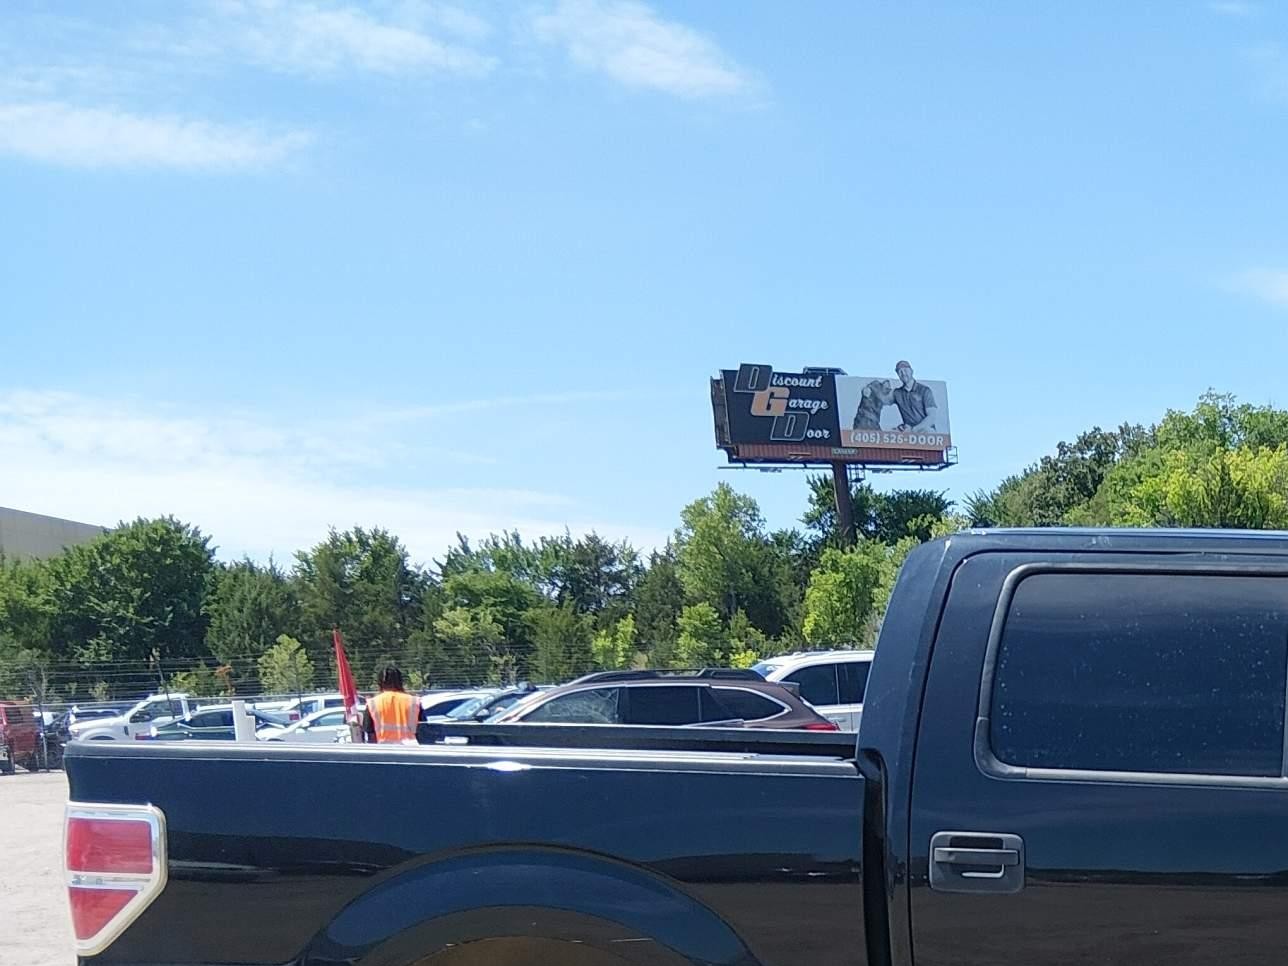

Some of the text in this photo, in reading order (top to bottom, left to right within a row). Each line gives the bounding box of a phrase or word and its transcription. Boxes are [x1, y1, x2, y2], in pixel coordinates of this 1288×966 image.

[734, 363, 823, 393] Discount
[751, 387, 829, 416] Garage
[770, 411, 831, 441] Door
[850, 432, 880, 444] (405)
